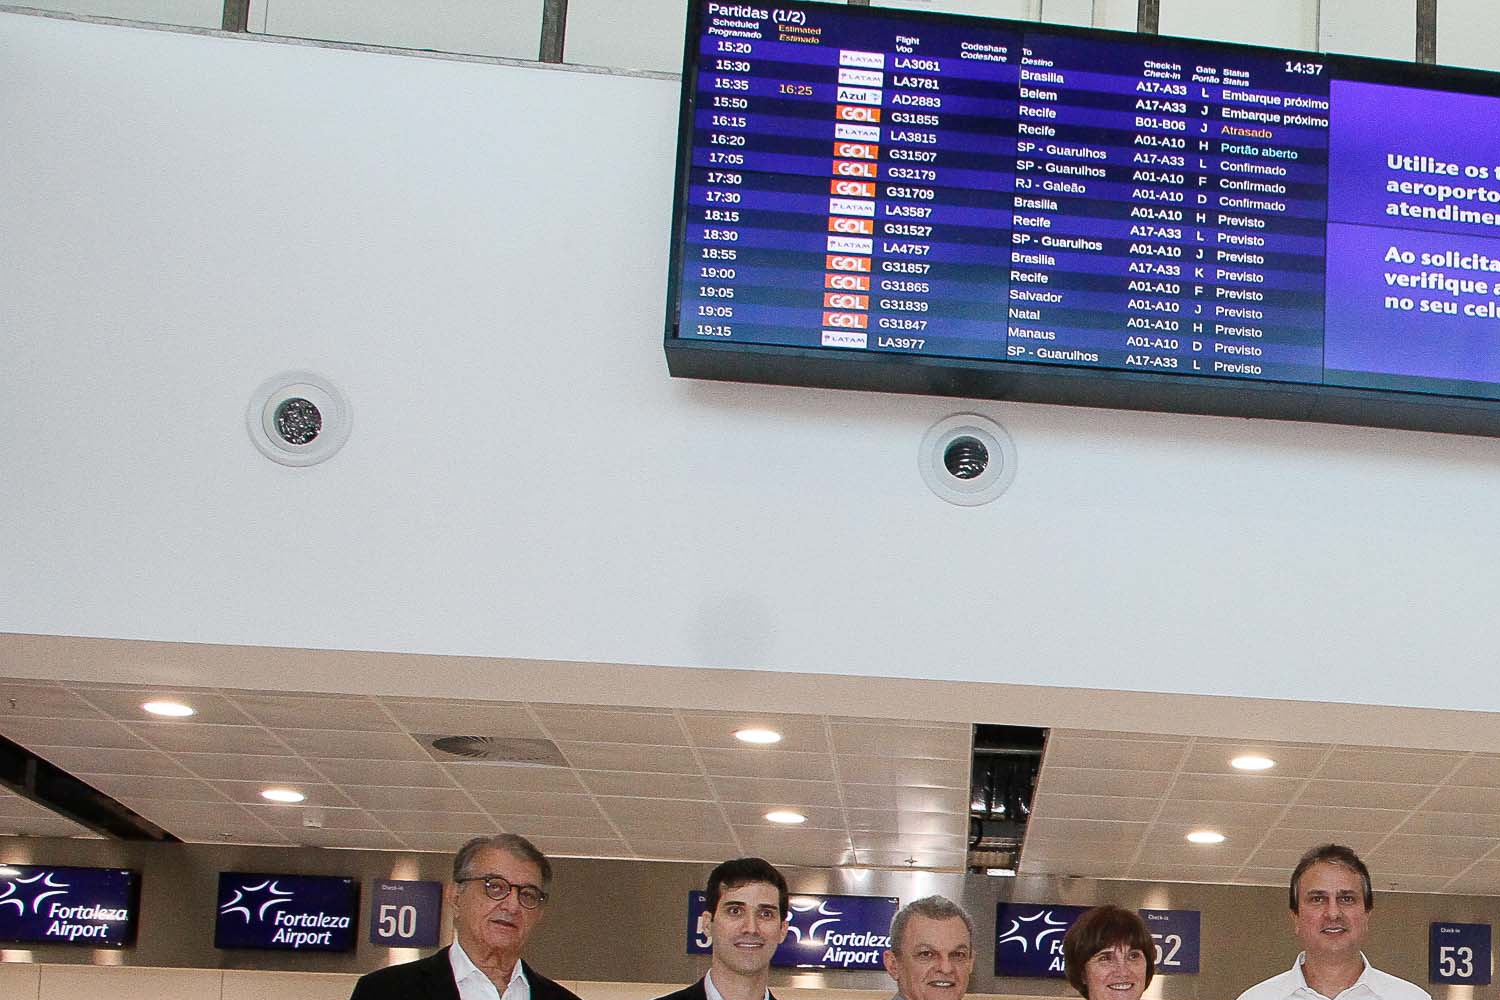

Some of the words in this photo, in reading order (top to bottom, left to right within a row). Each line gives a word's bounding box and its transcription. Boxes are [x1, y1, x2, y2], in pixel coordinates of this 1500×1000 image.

[709, 3, 768, 19] Partidas
[773, 9, 806, 25] (1/2)
[713, 19, 759, 29] Scheduled
[779, 25, 821, 34] Estimated
[708, 27, 762, 39] Programado
[896, 36, 919, 45] Flight
[718, 41, 751, 53] 15:20
[716, 60, 750, 72] 15:30
[895, 58, 940, 71] LA3061
[1021, 57, 1053, 67] Destino
[1286, 61, 1323, 75] 14:37
[715, 78, 749, 90] 15:35
[894, 76, 939, 90] LA3781
[780, 84, 812, 95] 16:25
[1020, 88, 1057, 100] Belem
[714, 97, 747, 108] 15:50
[892, 94, 941, 107] AD2883
[1222, 90, 1281, 105] Embarque
[1284, 98, 1329, 110] próximo
[1019, 106, 1056, 118] Recife
[1221, 107, 1281, 123] Embarque
[1284, 115, 1329, 127] próximo
[713, 116, 746, 127] 16:15
[892, 113, 939, 125] G31855
[1019, 124, 1055, 136] Recife
[1222, 126, 1272, 138] Atrasado
[711, 134, 745, 146] 16:20
[891, 131, 936, 143] LA3815
[890, 150, 937, 162] G31507
[1221, 143, 1259, 156] Portão
[1261, 147, 1298, 159] aberto
[710, 153, 743, 164] 17:05
[1220, 161, 1286, 176] Confirmado
[1387, 153, 1459, 176] Utilize
[1464, 165, 1489, 179] os
[708, 173, 742, 184] 17:30
[889, 168, 936, 180] G32179
[1220, 179, 1286, 193] Confirmado
[706, 191, 740, 203] 17:30
[887, 187, 934, 200] G31709
[1220, 197, 1285, 211] Confirmado
[705, 210, 739, 222] 18:15
[886, 205, 932, 218] LA3587
[1014, 215, 1051, 228] Recife
[1219, 215, 1265, 228] Previsto
[704, 229, 738, 241] 18:30
[884, 224, 932, 236] G31527
[1218, 233, 1264, 246] Previsto
[702, 248, 736, 260] 18:55
[884, 243, 930, 255] LA4757
[1384, 246, 1416, 264] Ao
[1217, 251, 1264, 264] Previsto
[701, 268, 735, 279] 19:00
[882, 262, 930, 274] G31857
[1011, 271, 1048, 283] Recife
[1217, 269, 1263, 283] Previsto
[881, 280, 929, 293] G31865
[1384, 271, 1488, 297] verifique
[700, 287, 734, 298] 19:05
[1010, 290, 1062, 303] Salvador
[1216, 288, 1263, 301] Previsto
[698, 306, 733, 317] 19:05
[880, 299, 928, 312] G31839
[1384, 296, 1414, 311] no
[1419, 299, 1458, 315] seu
[1009, 308, 1040, 320] Natal
[1216, 306, 1263, 319] Previsto
[879, 318, 927, 330] G31847
[697, 325, 731, 336] 19:15
[1009, 327, 1055, 340] Manaus
[1216, 325, 1262, 337] Previsto
[878, 337, 925, 349] LA3977
[1215, 343, 1262, 356] Previsto
[1215, 361, 1261, 374] Previsto
[49, 903, 128, 921] Fortaleza
[275, 911, 350, 928] Fortaleza
[378, 905, 417, 938] 50
[46, 921, 109, 941] Airport
[272, 928, 332, 948] Airport
[822, 947, 879, 967] Airport
[1440, 946, 1473, 977] 53
